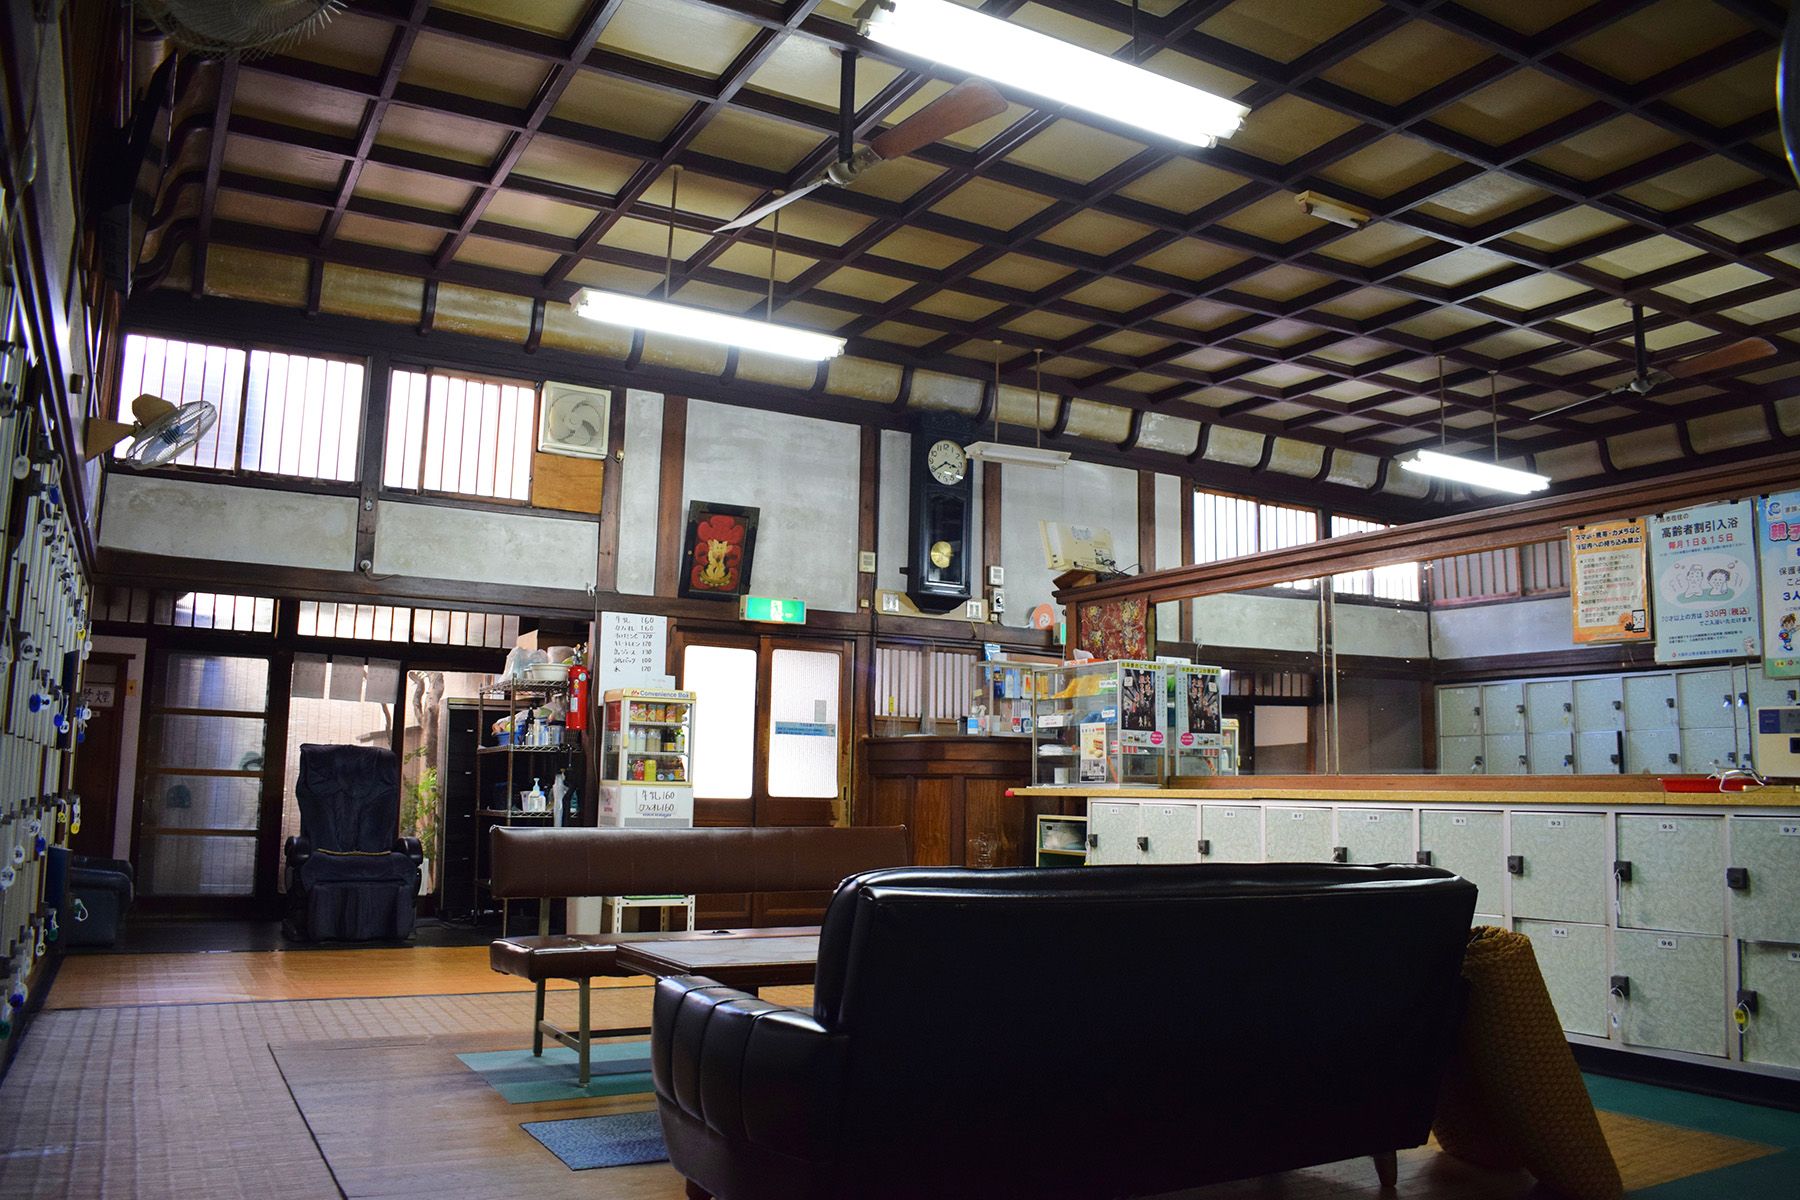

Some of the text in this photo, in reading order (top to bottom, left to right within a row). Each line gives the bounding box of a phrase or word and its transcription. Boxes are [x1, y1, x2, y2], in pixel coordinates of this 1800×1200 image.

[1661, 517, 1739, 539] 高齢者割引入浴
[615, 616, 631, 624] 牛乳
[84, 688, 111, 704] 禁煙
[640, 690, 677, 698] Convenience
[641, 789, 675, 801] 牛乳 160
